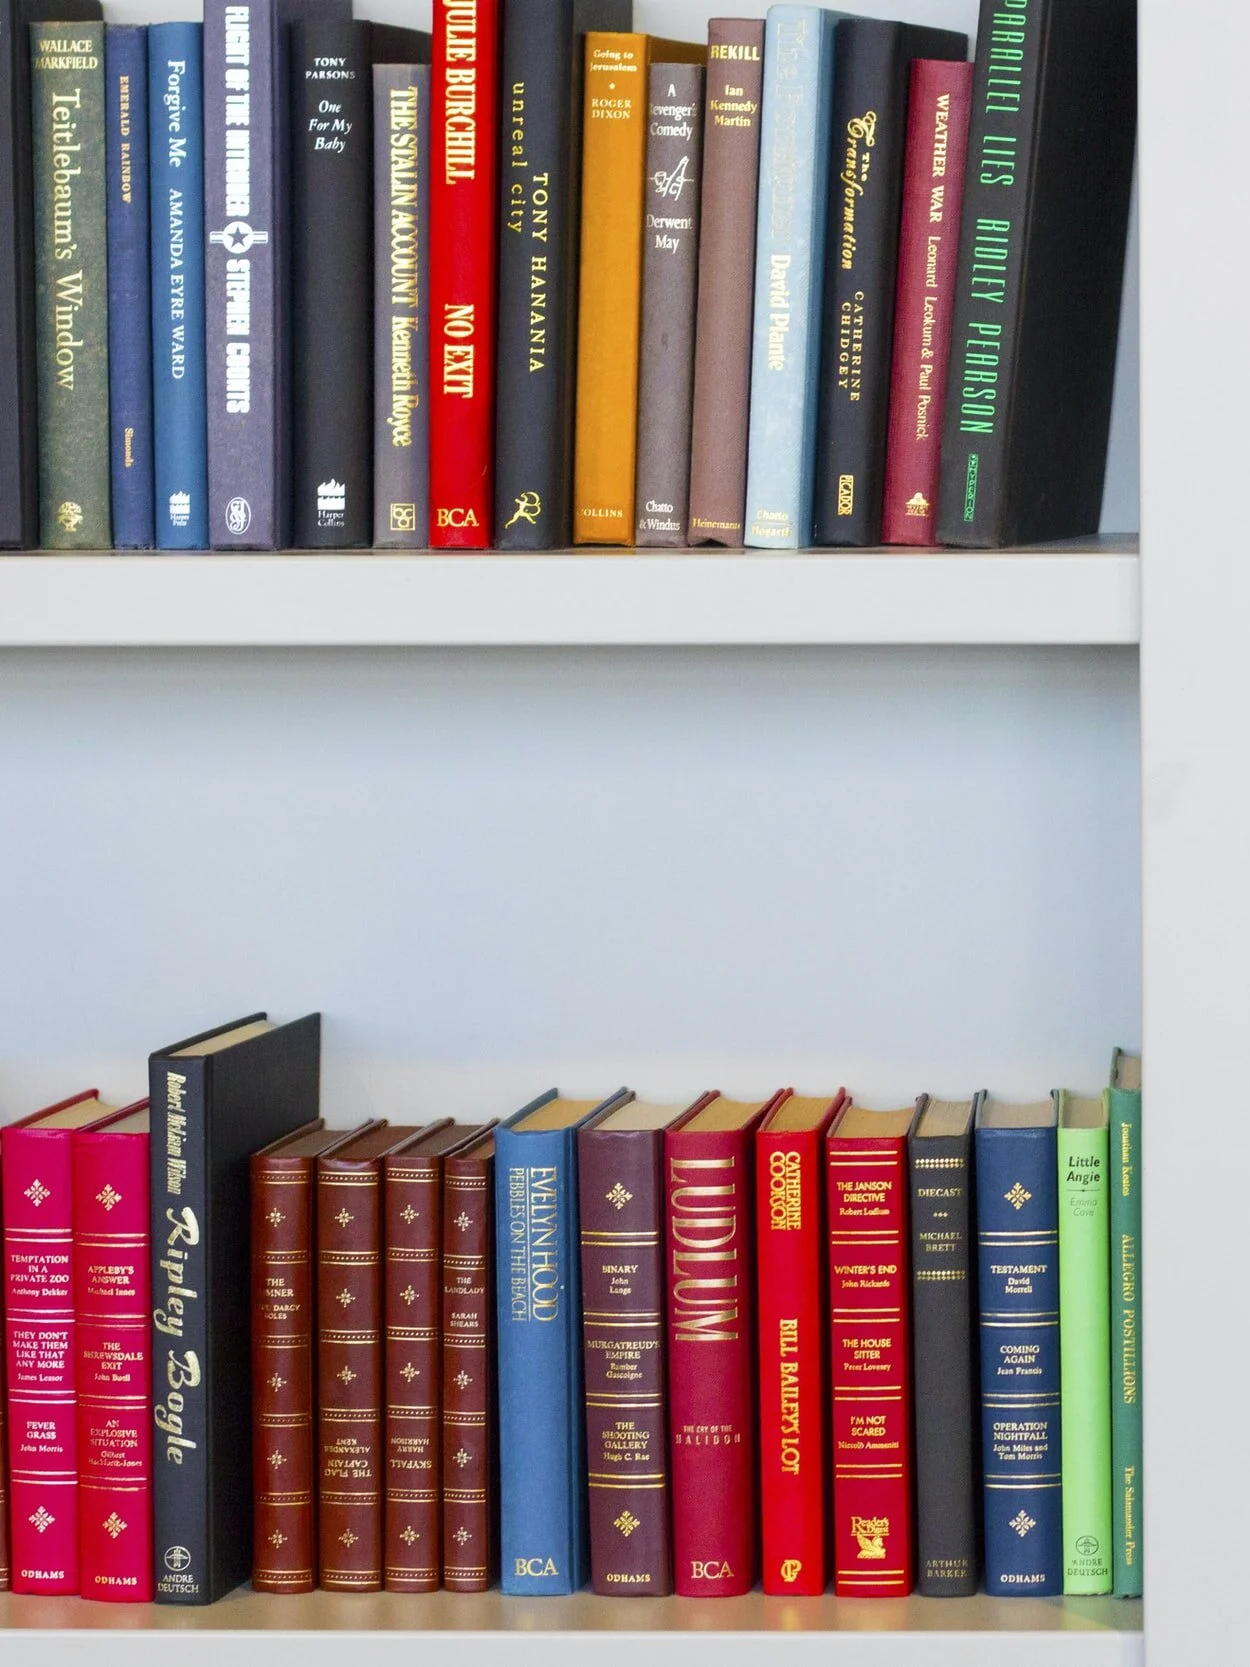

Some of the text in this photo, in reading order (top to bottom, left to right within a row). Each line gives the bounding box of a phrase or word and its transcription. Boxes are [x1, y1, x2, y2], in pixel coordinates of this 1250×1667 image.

[39, 39, 93, 53] WALLACE
[711, 45, 760, 61] REKILL
[35, 56, 98, 70] MARKFIELD
[314, 57, 346, 67] TONY
[305, 71, 355, 80] PARSONS
[444, 0, 476, 185] JULIE BURCHILL
[725, 85, 743, 96] Ian
[318, 100, 342, 114] One
[710, 100, 757, 114] Kennedy
[308, 119, 352, 135] For My
[714, 116, 751, 127] Martin
[931, 94, 950, 177] WEATHER
[314, 137, 346, 154] Baby
[508, 83, 527, 233] unreal city
[980, 136, 1017, 186] LIES
[929, 185, 944, 223] WAR
[164, 60, 187, 379] Forgive Me AMANDA EYRE WARD
[52, 88, 84, 391] Teitlebaum's Window
[925, 236, 941, 288] Leonard
[972, 218, 1010, 303] RIDLEY
[529, 173, 548, 372] TONY HANANIA
[443, 304, 475, 399] NO EXIT
[920, 347, 933, 359] &
[919, 364, 933, 391] Paul
[960, 322, 1002, 433] PEARSON
[916, 394, 931, 441] Posnick
[1069, 1156, 1100, 1168] Little
[1067, 1171, 1101, 1185] Angie
[770, 1151, 787, 1231] COOKSON
[786, 1151, 801, 1231] CATHERINE
[837, 1181, 892, 1191] THE JANSON
[843, 1193, 885, 1202] DIRECTIVE
[531, 1167, 559, 1322] EVELYN HOOD
[671, 1156, 738, 1341] LUDLUM
[11, 1255, 69, 1263] TEMPTATION
[834, 1264, 897, 1274] WINTER'S END
[990, 1265, 1047, 1274] TESTAMENT
[10, 1274, 69, 1283] PRIVATE ZOO
[154, 1206, 200, 1464] Ripley Bogle
[1000, 1345, 1040, 1353] COMING
[1004, 1355, 1035, 1363] AGAIN
[780, 1319, 800, 1475] BILL BAILEY'S LOT
[27, 1421, 55, 1430] FEVER
[993, 1422, 1047, 1431] OPERATION
[27, 1430, 56, 1440] GRASS
[602, 1430, 650, 1440] SHOOTING
[994, 1431, 1048, 1440] NIGHTFALL
[604, 1440, 648, 1450] GALLERY
[21, 1569, 65, 1579] ODHAMS
[515, 1558, 558, 1576] BCA
[1001, 1574, 1045, 1583] ODHAMS
